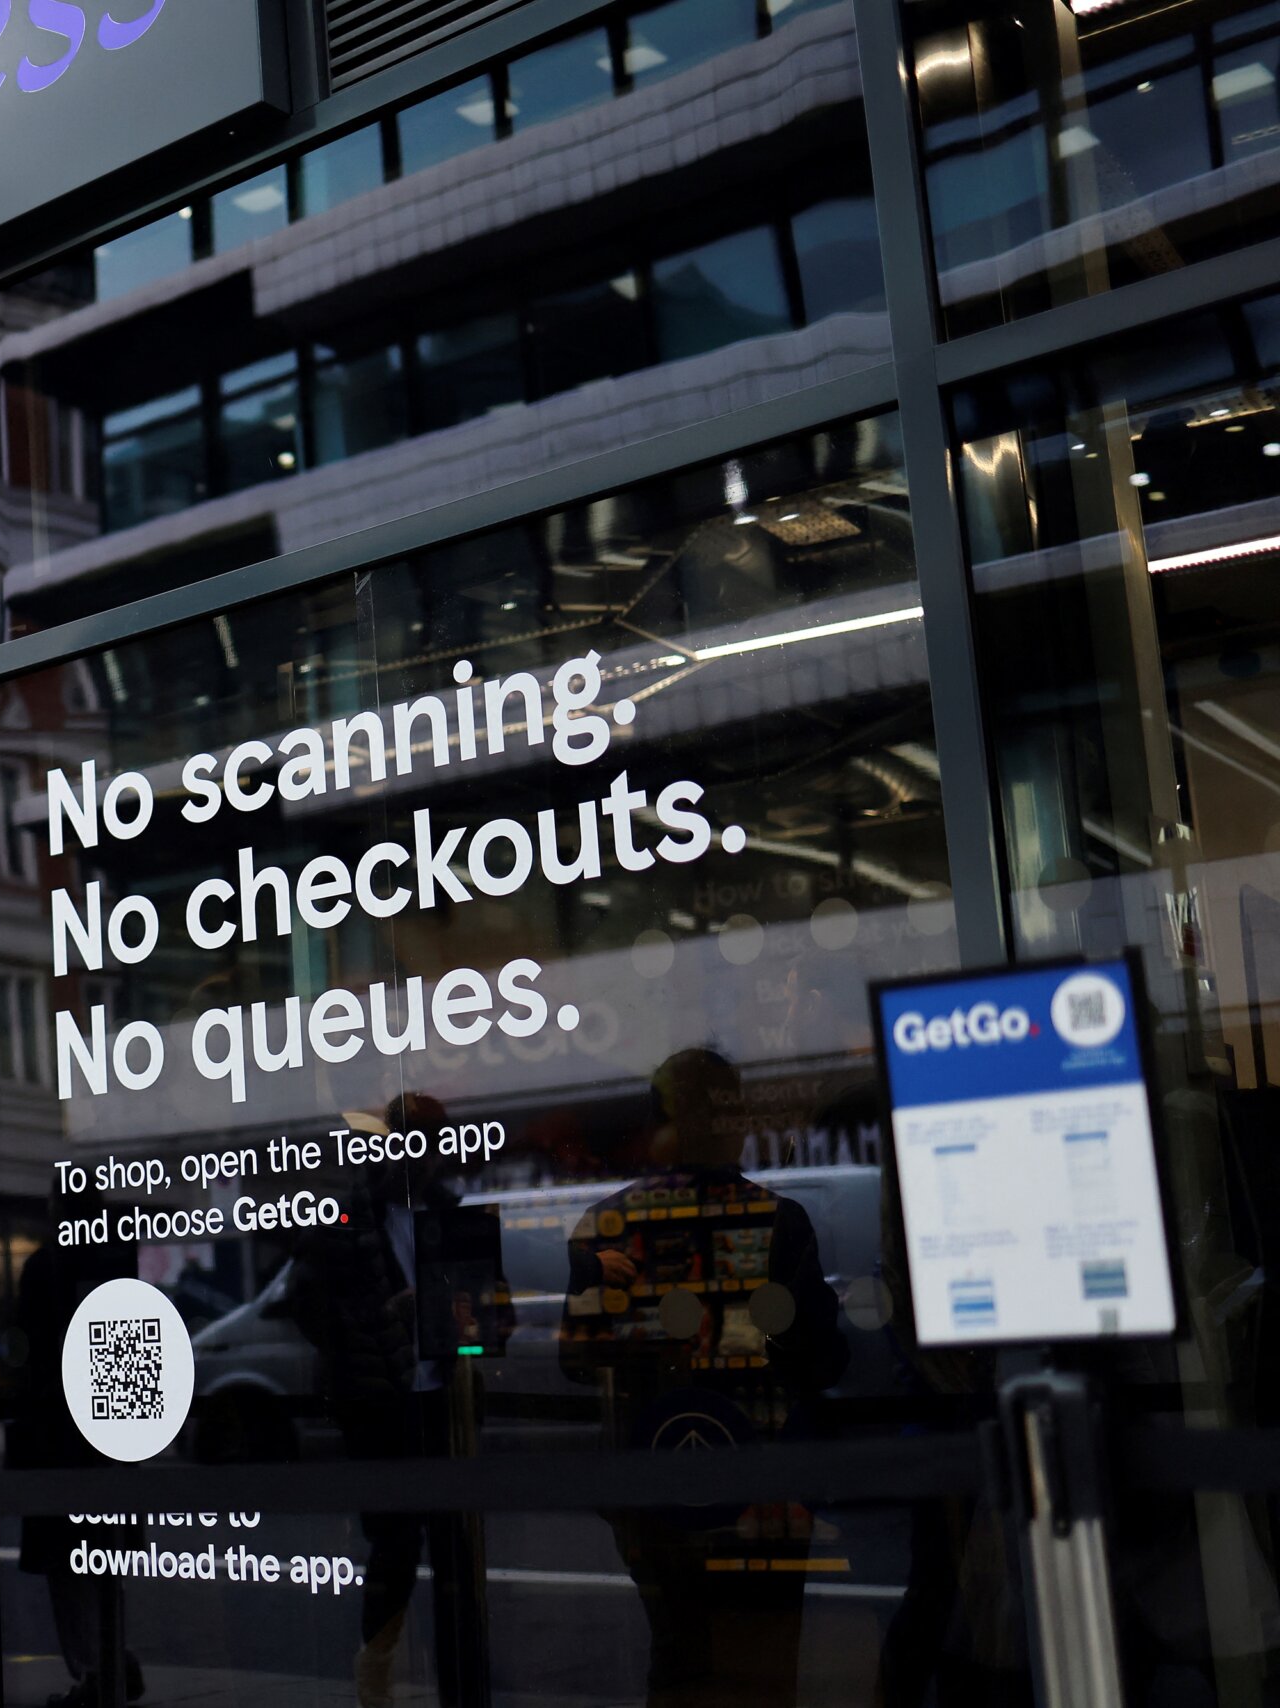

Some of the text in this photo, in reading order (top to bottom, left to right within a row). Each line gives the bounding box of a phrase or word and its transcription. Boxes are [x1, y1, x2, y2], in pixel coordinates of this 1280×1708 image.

[47, 648, 638, 856] No scanning.
[51, 769, 748, 977] No checkouts.
[55, 1004, 165, 1100] No
[191, 958, 581, 1105] queues.
[54, 1121, 506, 1195] To shop, open the Tesco app
[57, 1190, 350, 1247] and choose GetGo.
[69, 1539, 365, 1596] download the app.
